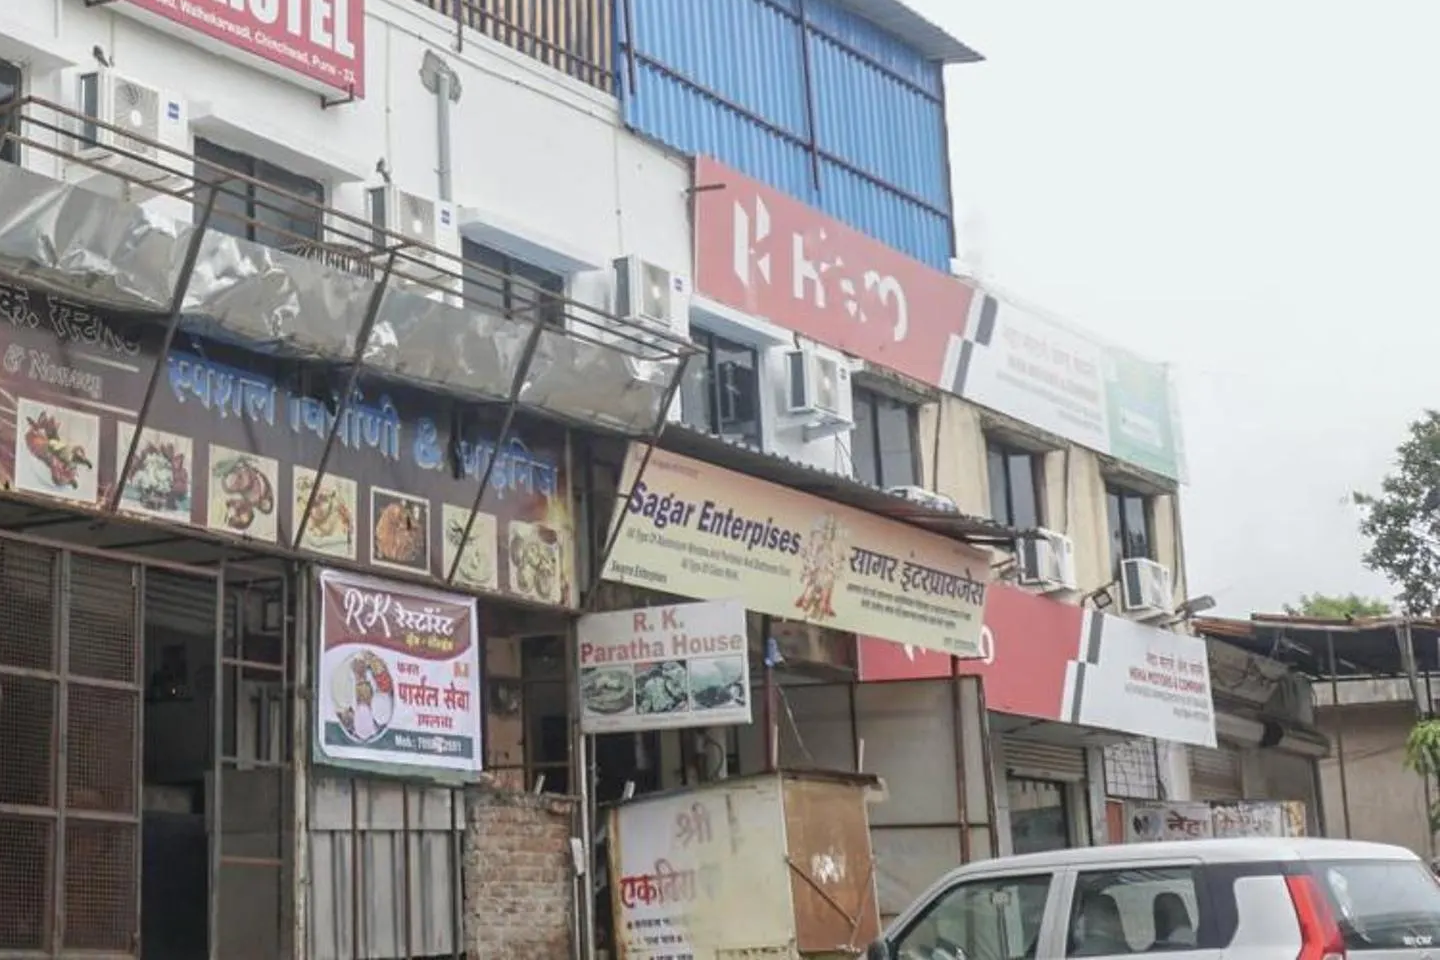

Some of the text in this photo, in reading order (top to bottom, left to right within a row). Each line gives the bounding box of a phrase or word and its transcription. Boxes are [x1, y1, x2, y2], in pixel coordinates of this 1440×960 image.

[629, 480, 696, 529] Sagar
[698, 501, 802, 557] Enterpises
[850, 545, 897, 583] सागर
[633, 609, 685, 635] R. K.
[580, 633, 744, 666] Paratha House
[398, 675, 470, 713] पार्सल सेवा
